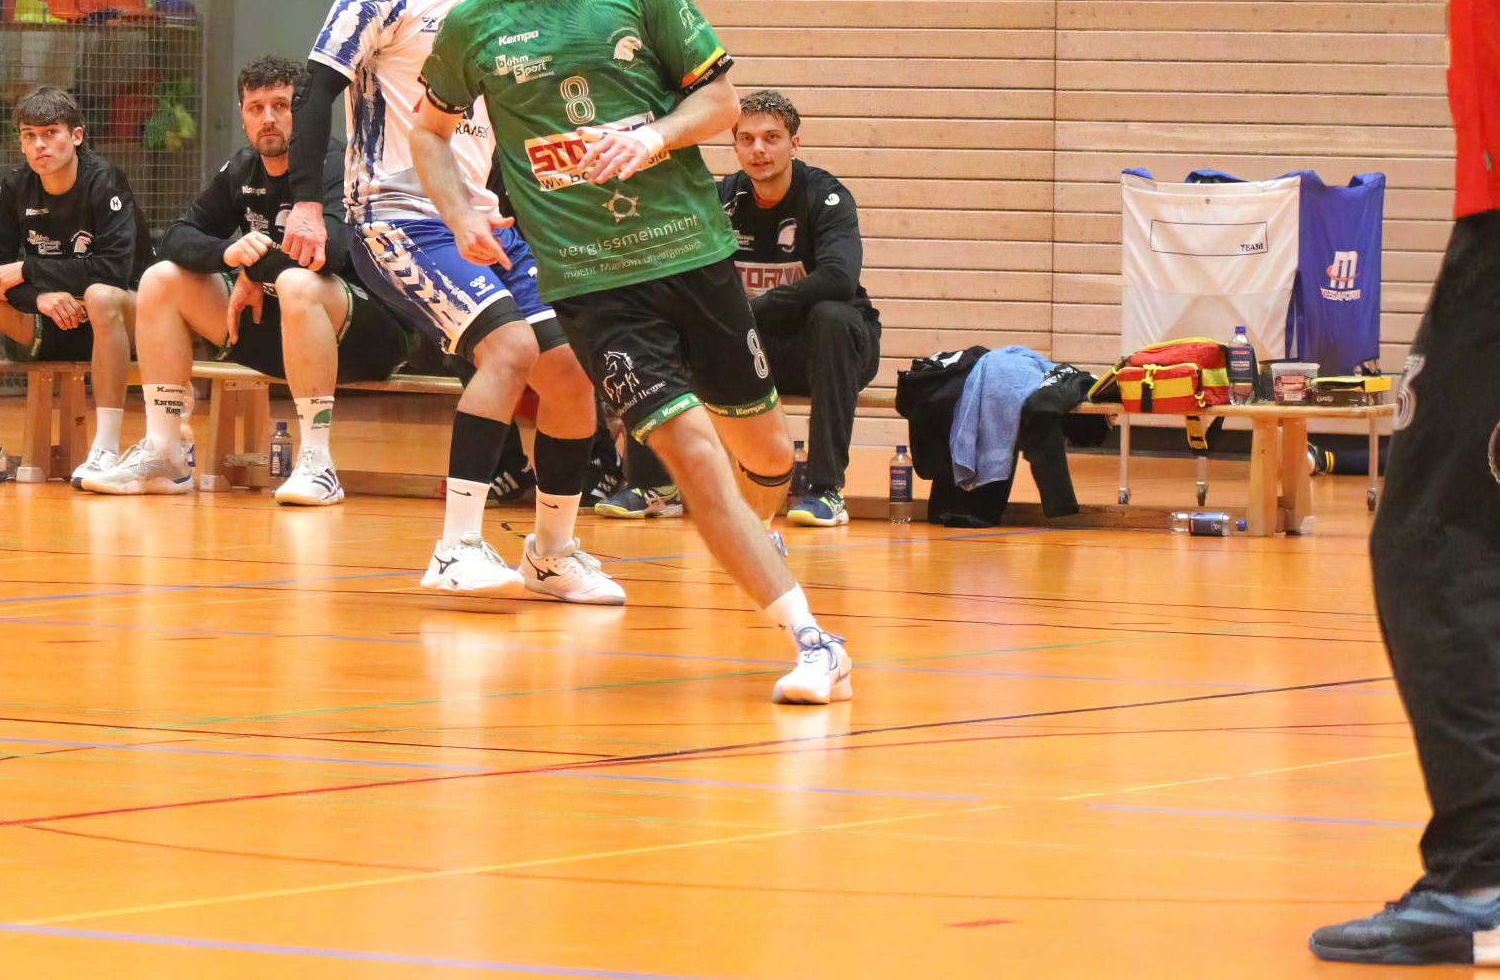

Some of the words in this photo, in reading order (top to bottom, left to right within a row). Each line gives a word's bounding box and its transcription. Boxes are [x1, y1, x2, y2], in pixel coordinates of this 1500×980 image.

[560, 75, 596, 125] 8
[541, 175, 565, 191] Wir
[558, 214, 698, 259] vergissmeinnicht
[746, 328, 769, 379] 8
